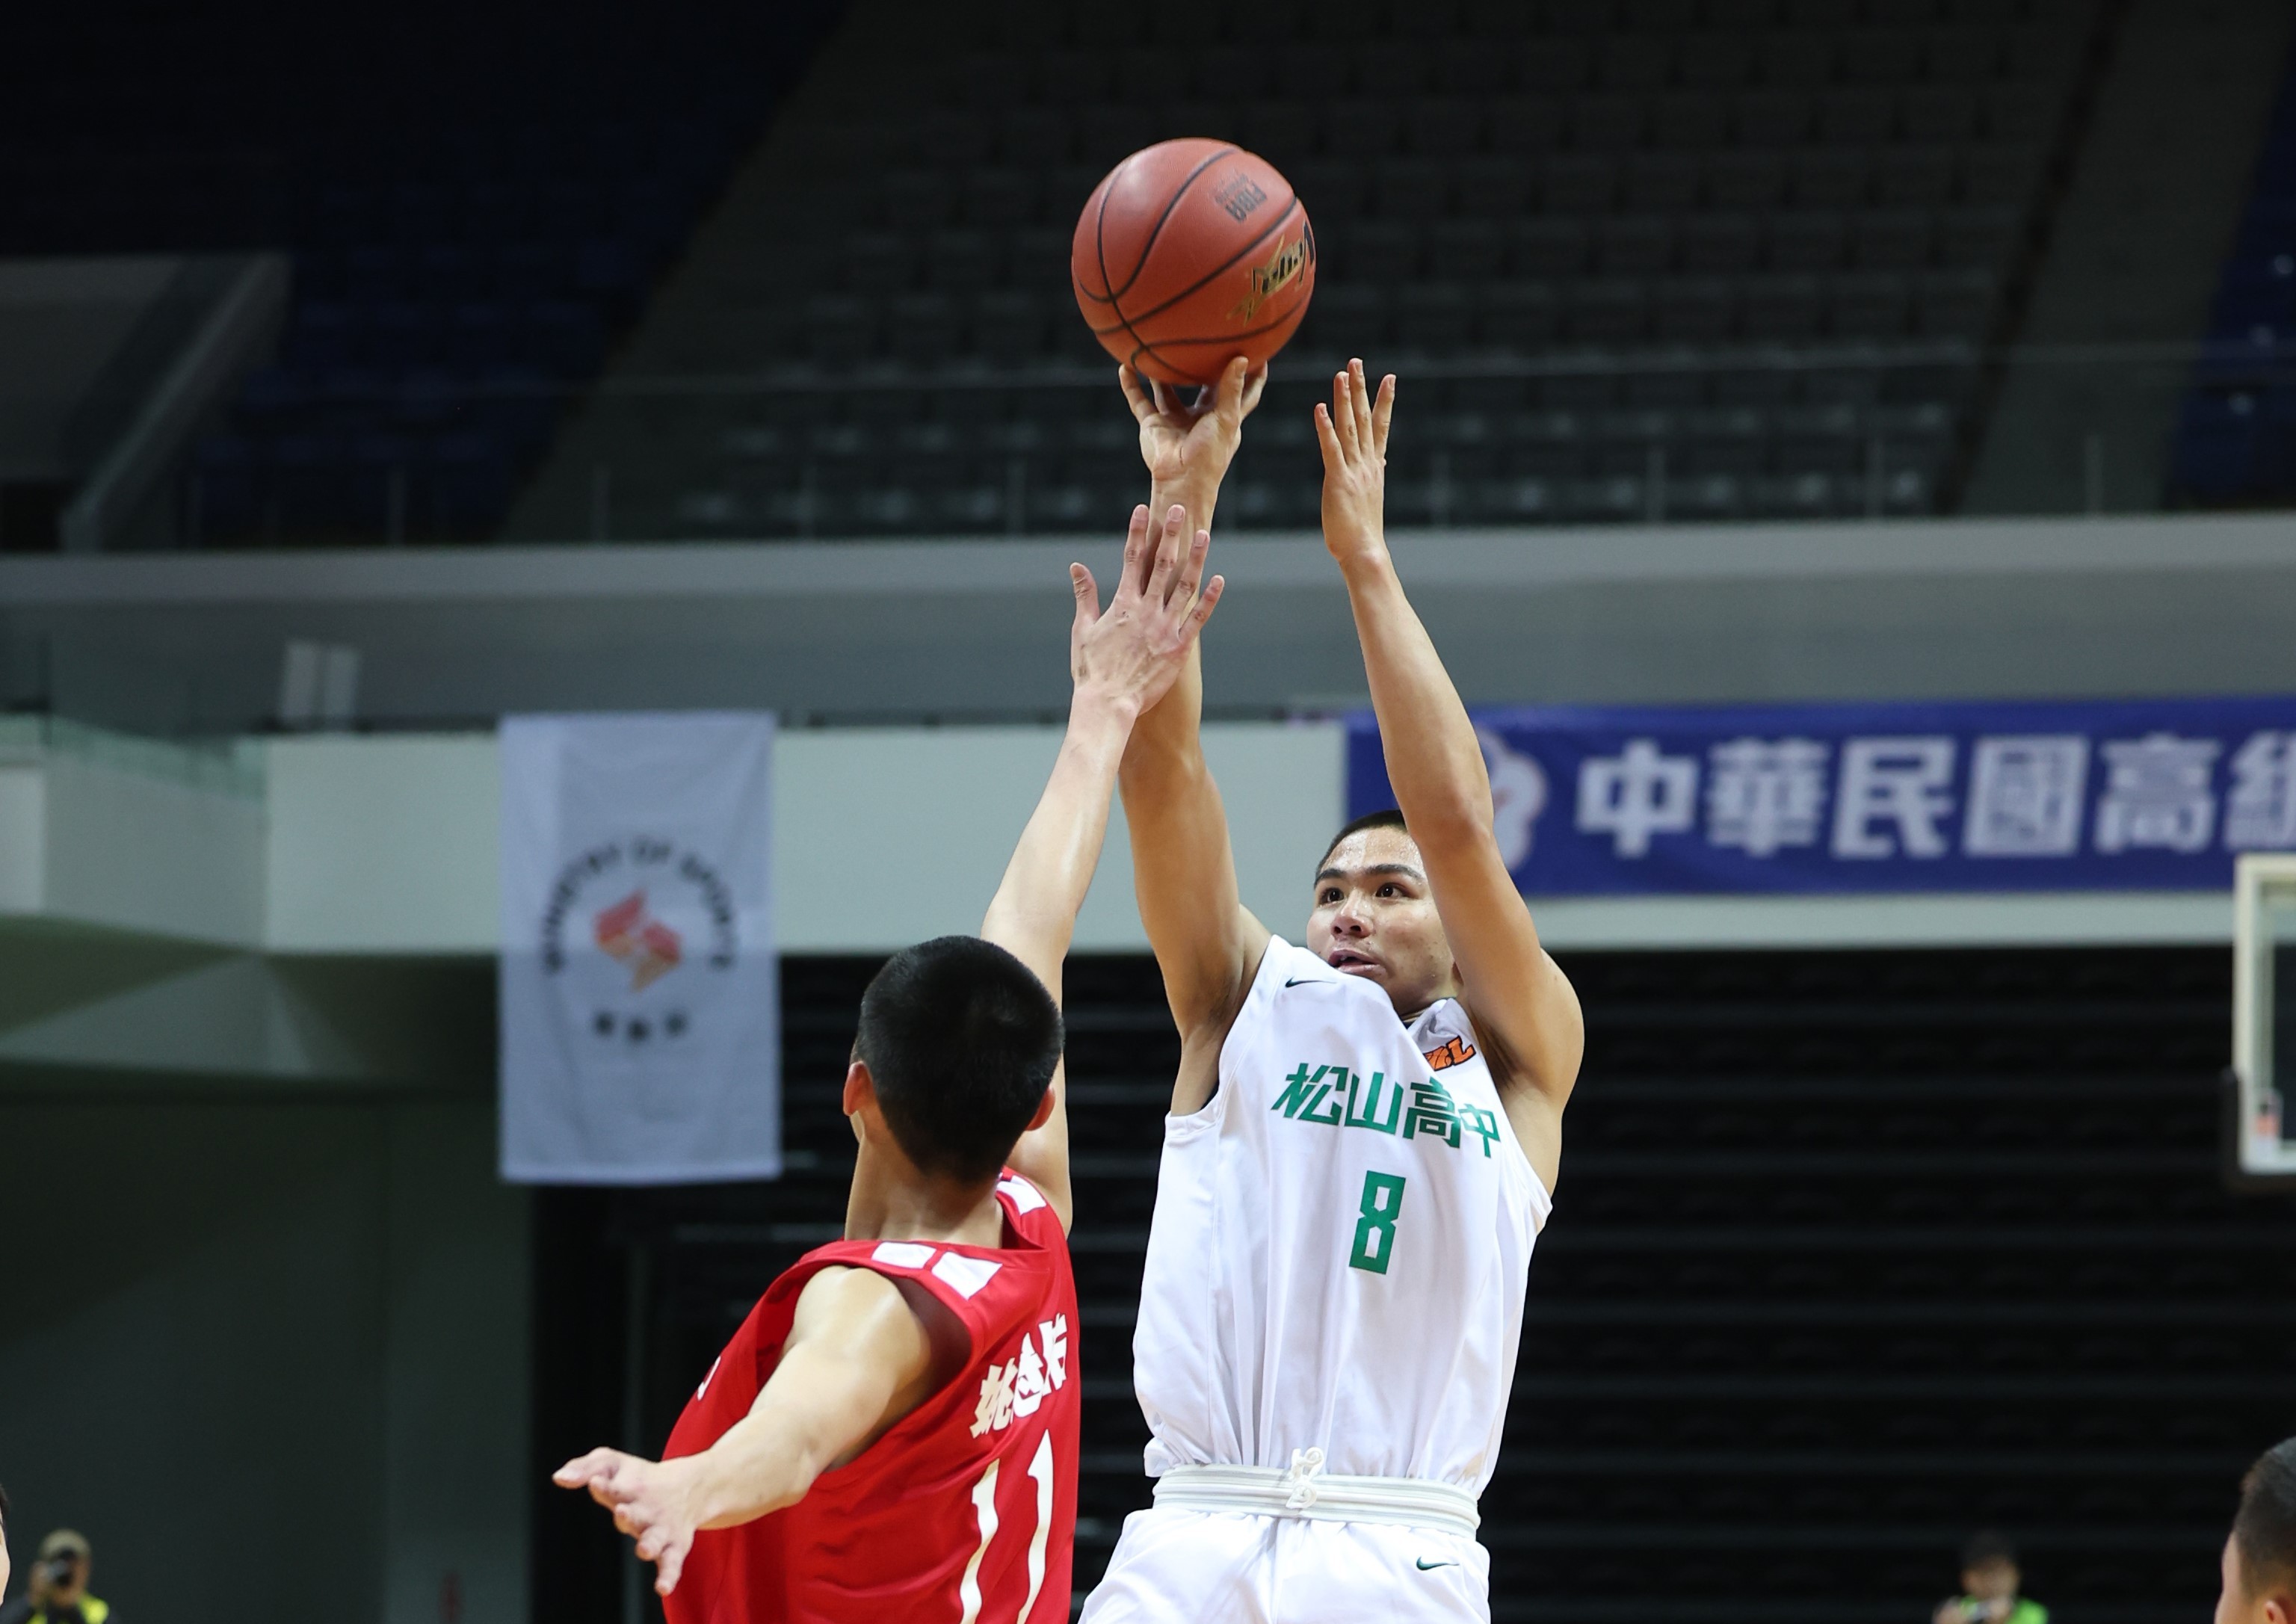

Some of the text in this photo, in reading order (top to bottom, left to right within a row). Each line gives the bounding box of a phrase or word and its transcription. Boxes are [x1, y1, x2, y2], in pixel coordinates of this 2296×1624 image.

[1225, 179, 1268, 223] FIBA
[1423, 1036, 1476, 1072] BL
[1271, 1063, 1501, 1158] 松山高中
[1349, 1170, 1406, 1275] 8
[960, 1429, 1054, 1624] 11
